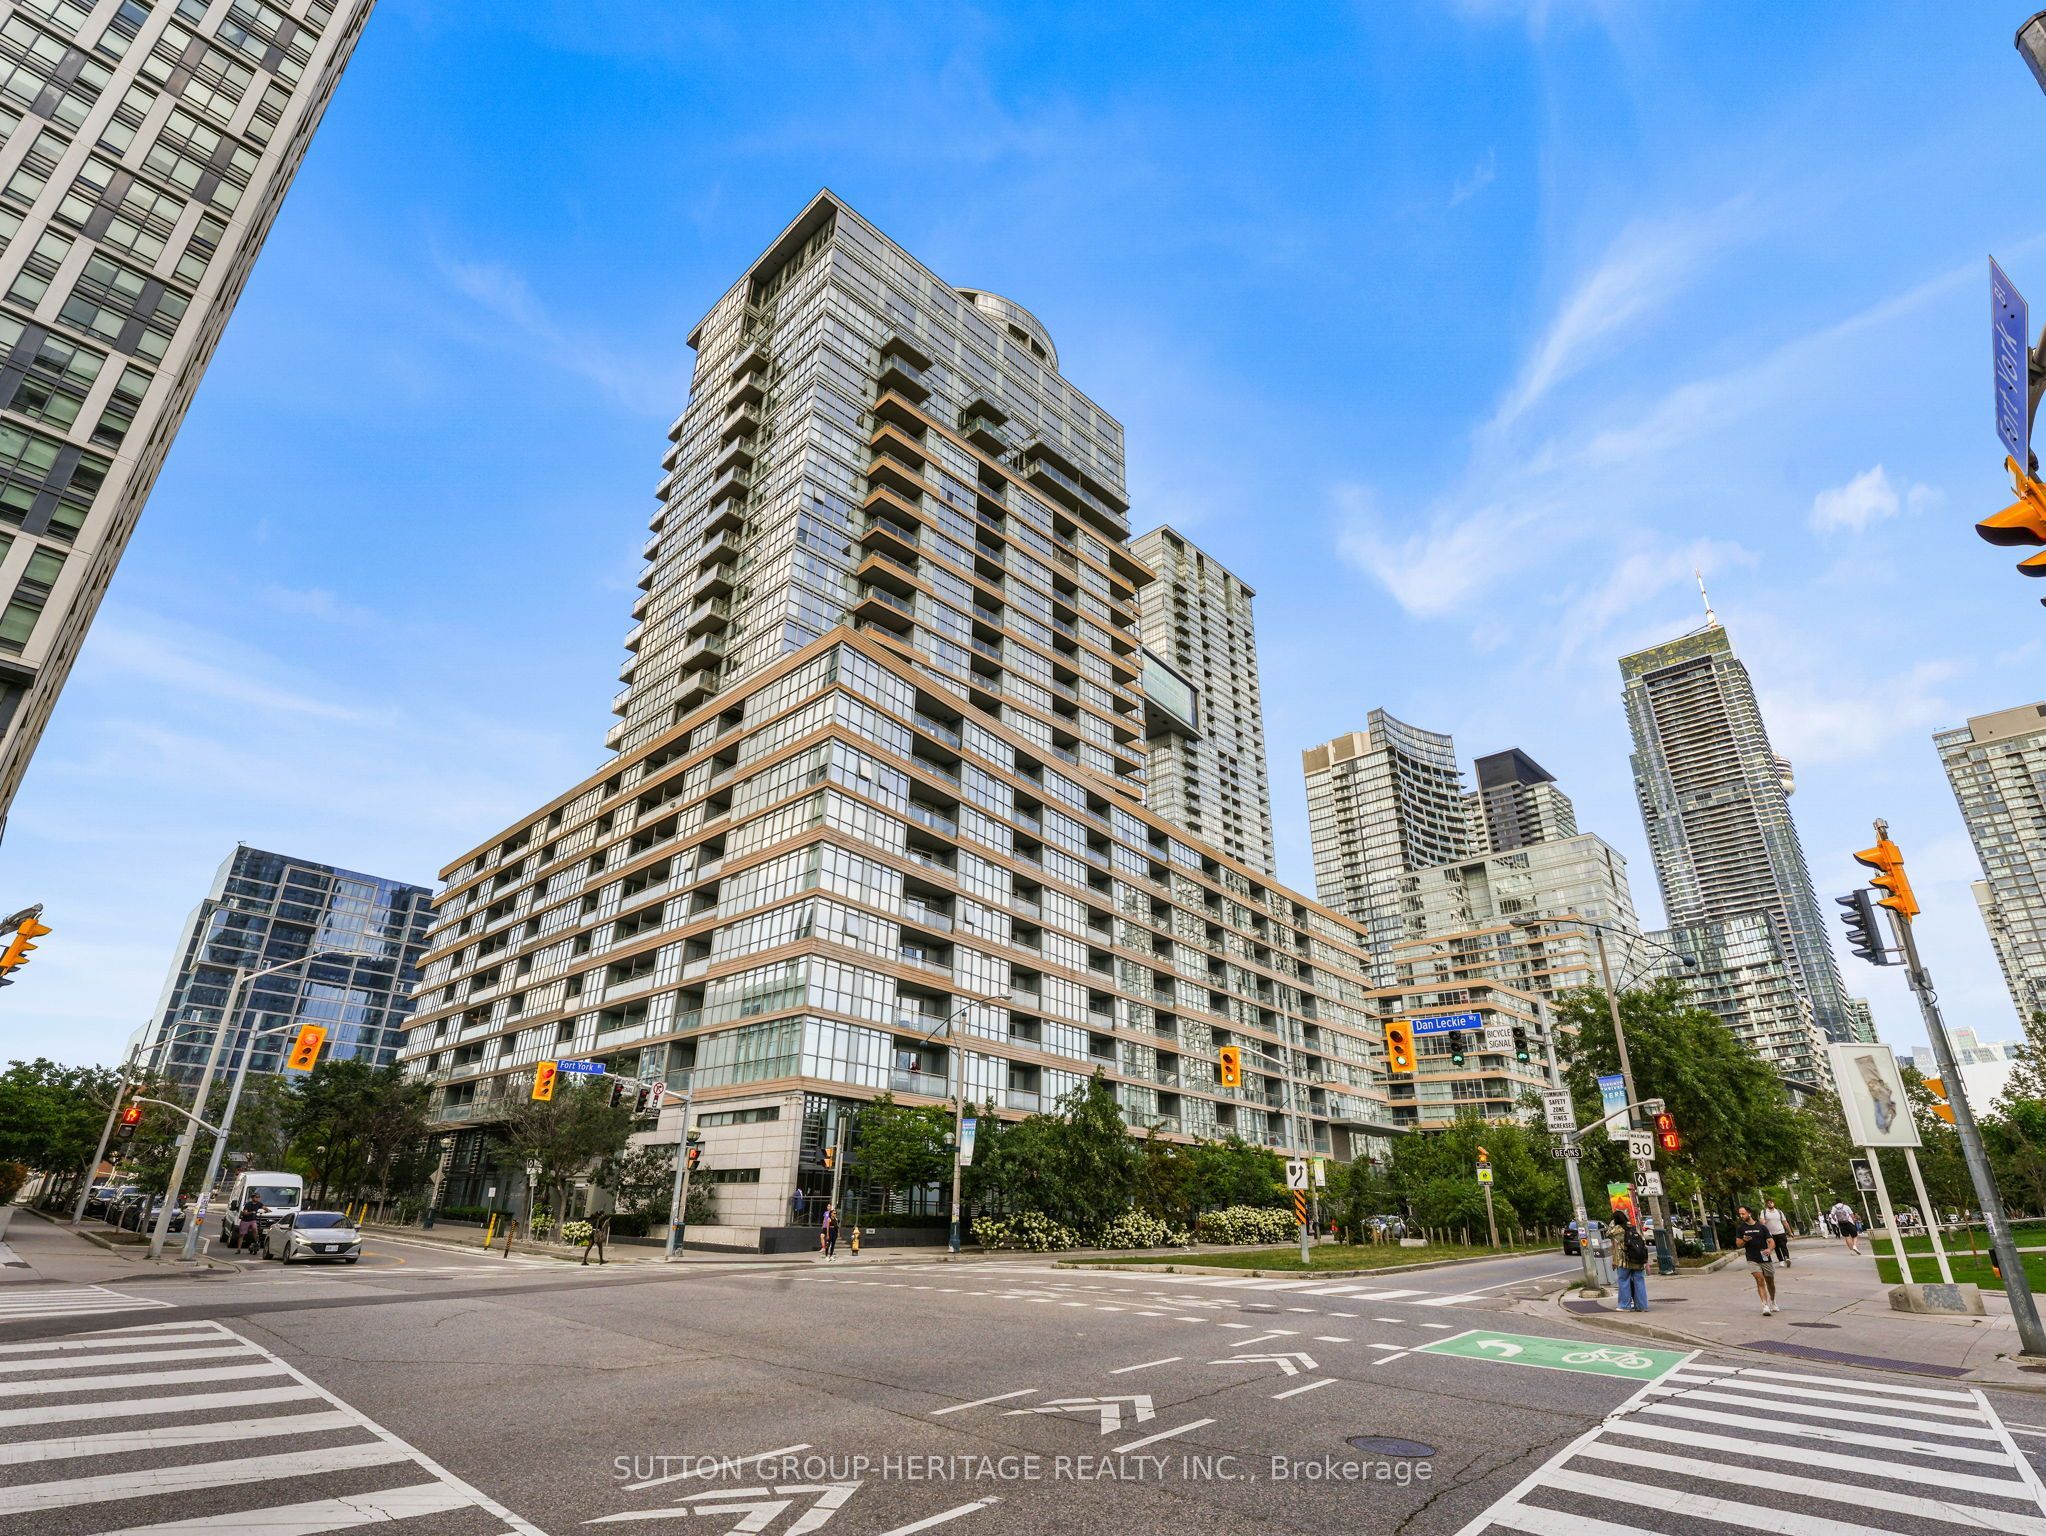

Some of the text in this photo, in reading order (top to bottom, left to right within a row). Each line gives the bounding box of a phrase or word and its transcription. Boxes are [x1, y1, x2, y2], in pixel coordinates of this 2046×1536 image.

[1995, 321, 2018, 394] York
[1999, 387, 2019, 453] Fort
[1416, 1020, 1434, 1031] Dan
[1436, 1016, 1466, 1029] Leckie
[1486, 1028, 1511, 1038] BICYCLE
[1488, 1039, 1512, 1048] SIGNAL
[559, 1061, 576, 1069] Fort
[577, 1062, 594, 1071] York
[1602, 1091, 1625, 1099] HERE
[1549, 1122, 1575, 1130] INCREASED
[1554, 1149, 1580, 1157] BEGINS
[1632, 1143, 1652, 1156] 30
